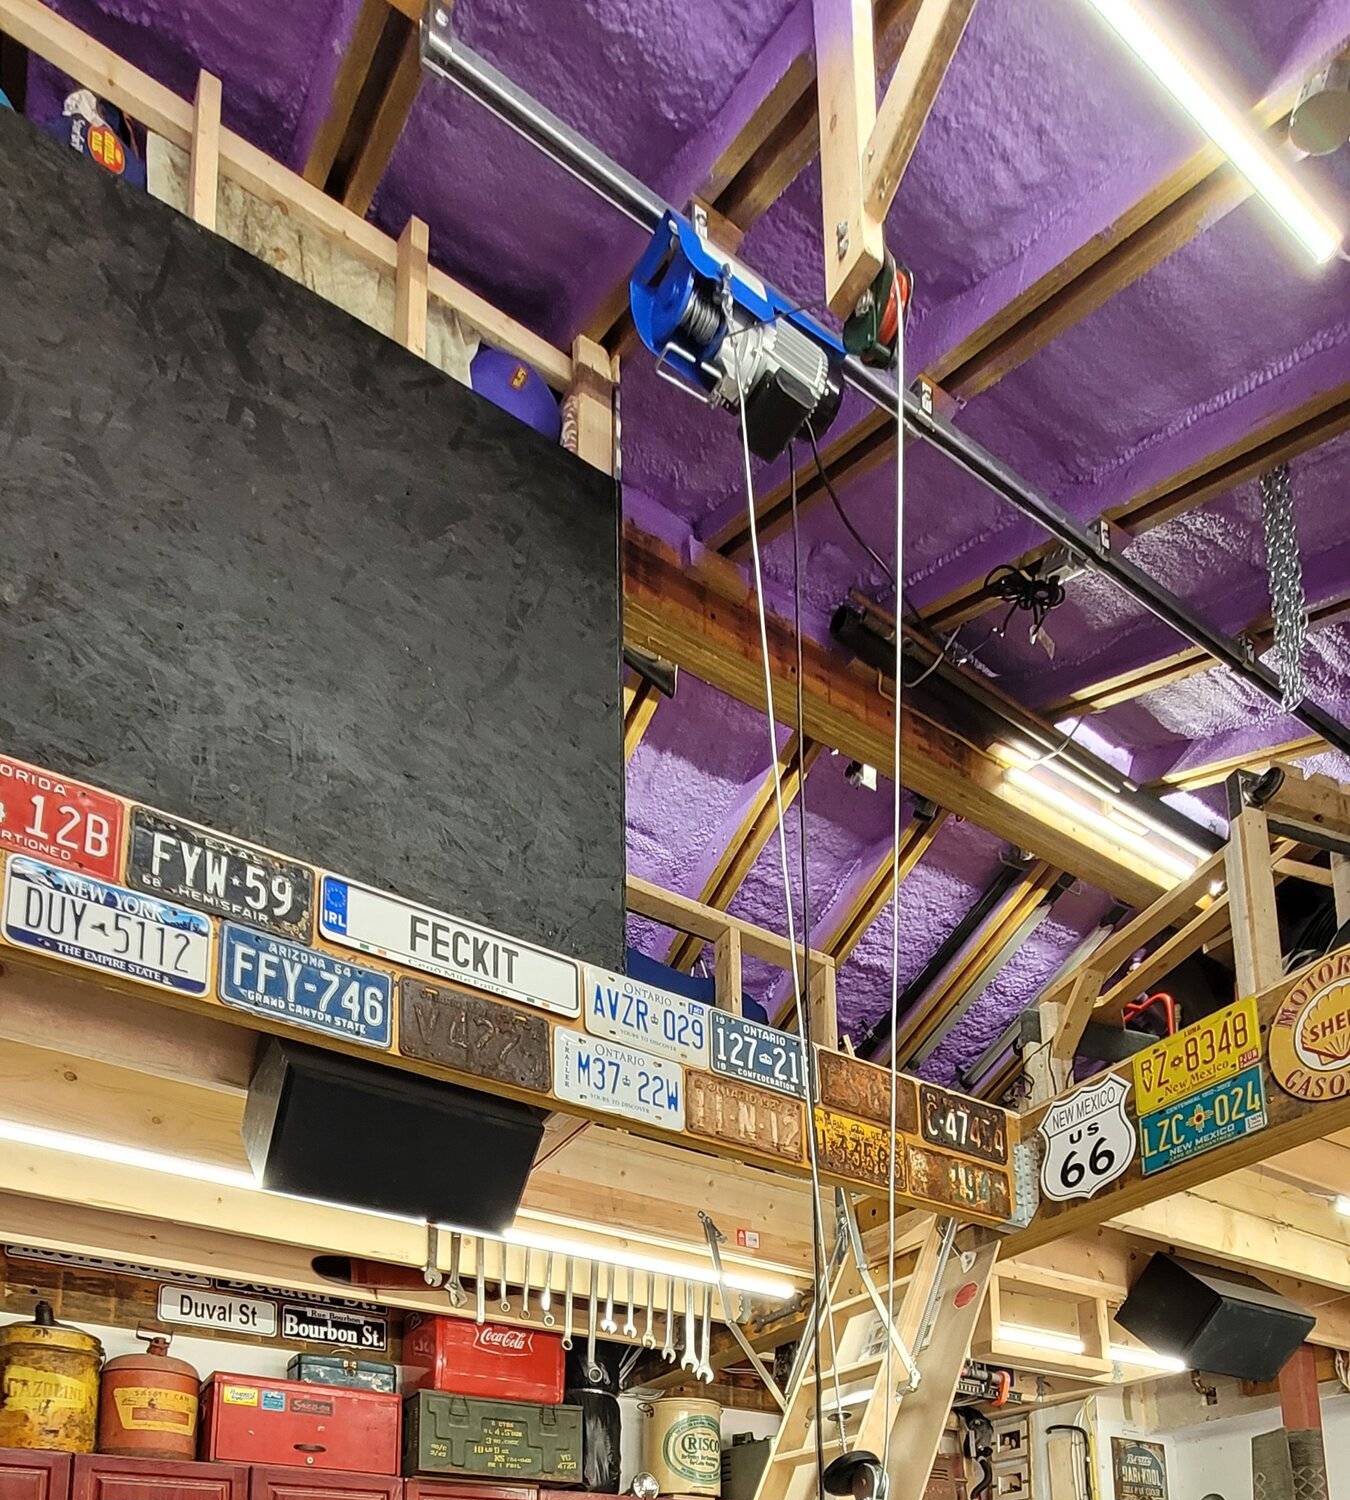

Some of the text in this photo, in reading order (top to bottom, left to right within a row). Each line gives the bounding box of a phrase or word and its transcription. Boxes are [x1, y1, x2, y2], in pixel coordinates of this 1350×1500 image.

[61, 878, 166, 923] NEW YORK
[178, 887, 269, 925] HEMISFAIR
[324, 909, 347, 928] IRL
[56, 942, 161, 981] THE EMPIRE STATE
[268, 943, 326, 969] ARIZONA
[409, 915, 519, 984] FECKIT
[593, 983, 649, 1034] AVZR
[624, 982, 672, 1007] ONTARIO
[247, 991, 366, 1034] GRAND CANYON STATE
[1310, 1008, 1350, 1043] SHE
[743, 1025, 786, 1047] ONTARIO
[594, 1043, 645, 1067] ONTARIO
[577, 1051, 679, 1112] M37 22W
[737, 1068, 796, 1092] CONFEDERATION
[1164, 1079, 1188, 1097] New
[1190, 1061, 1229, 1084] Mexico
[1284, 1069, 1350, 1098] GASO
[1052, 1086, 1116, 1131] NEW MEXICO
[1169, 1123, 1235, 1157] NEW MEXICO
[1060, 1136, 1116, 1188] 66
[180, 1294, 258, 1326] Duval St
[311, 1309, 327, 1319] Rue
[284, 1314, 385, 1347] Bourbon St.
